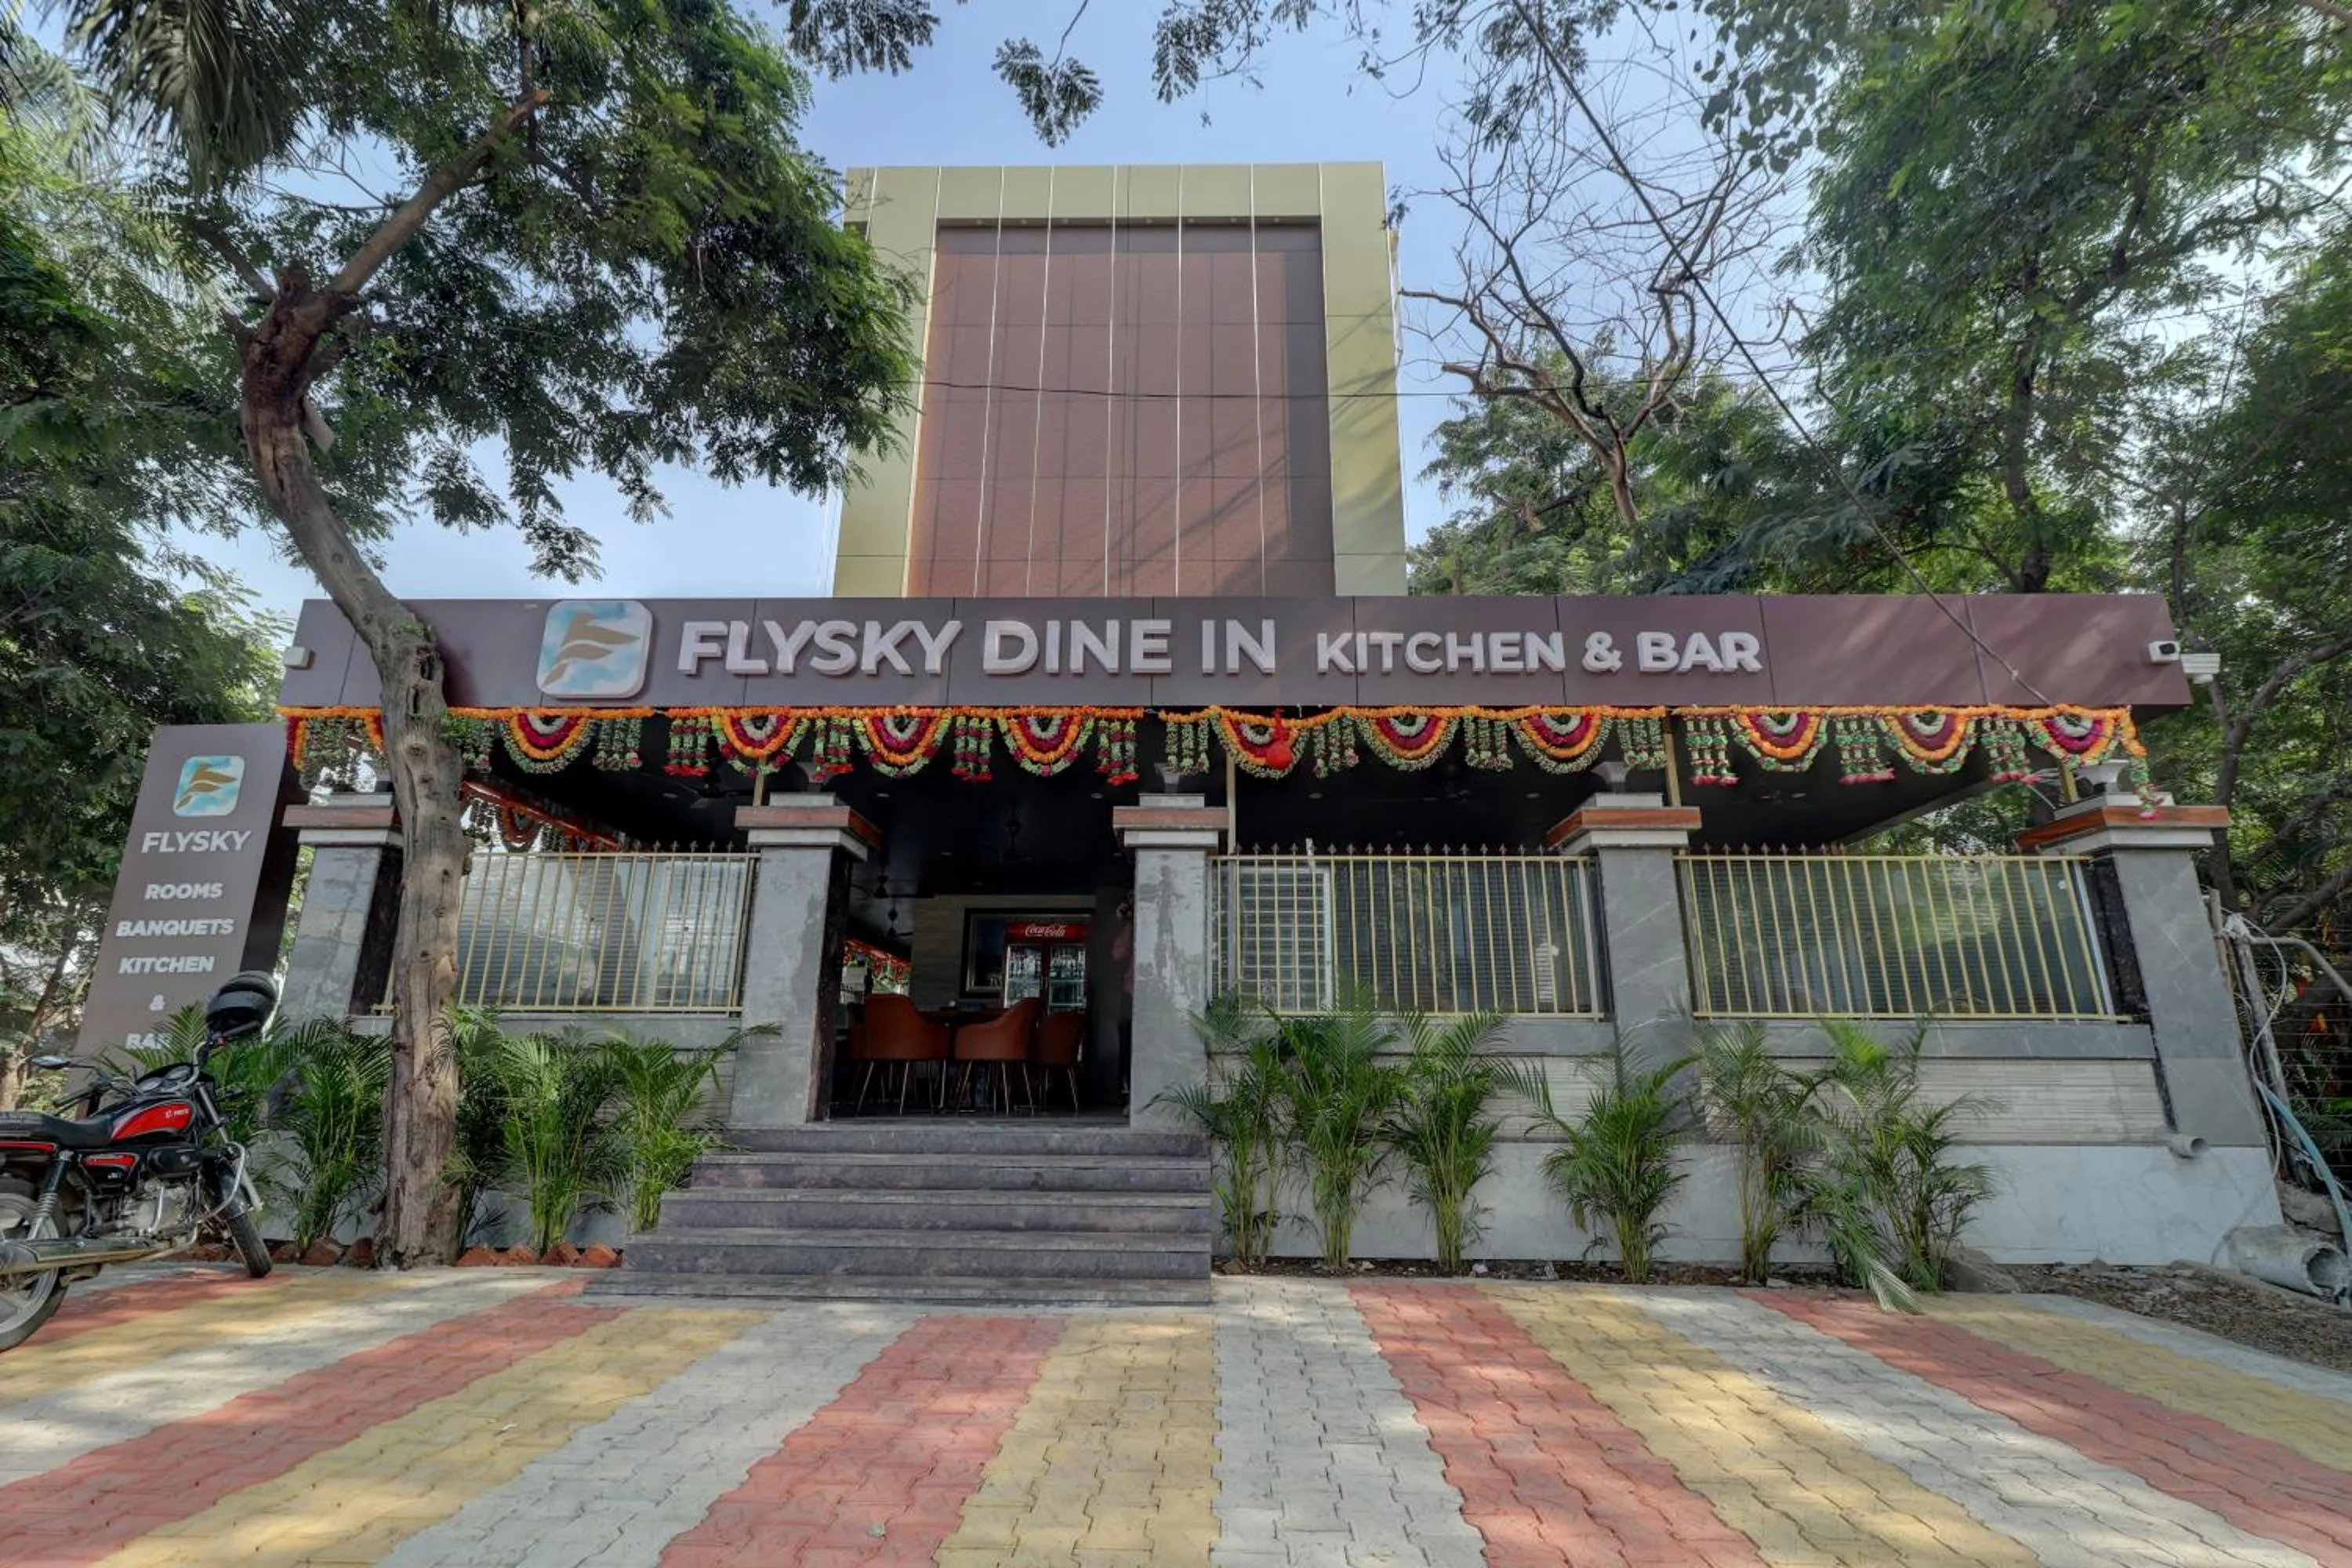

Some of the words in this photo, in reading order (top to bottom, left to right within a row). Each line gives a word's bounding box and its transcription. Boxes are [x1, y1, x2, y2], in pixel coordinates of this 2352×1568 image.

[677, 619, 963, 676] FLYSKY
[982, 619, 1173, 676] DINE
[1200, 618, 1276, 675] IN
[1316, 630, 1565, 674] KITCHEN
[1582, 631, 1622, 673] &
[1638, 630, 1763, 674] BAR
[141, 830, 252, 854] FLYSKY
[144, 883, 223, 901] ROOMS
[116, 919, 234, 937] BANQUETS
[118, 956, 216, 975] KITCHEN
[149, 994, 165, 1011] &
